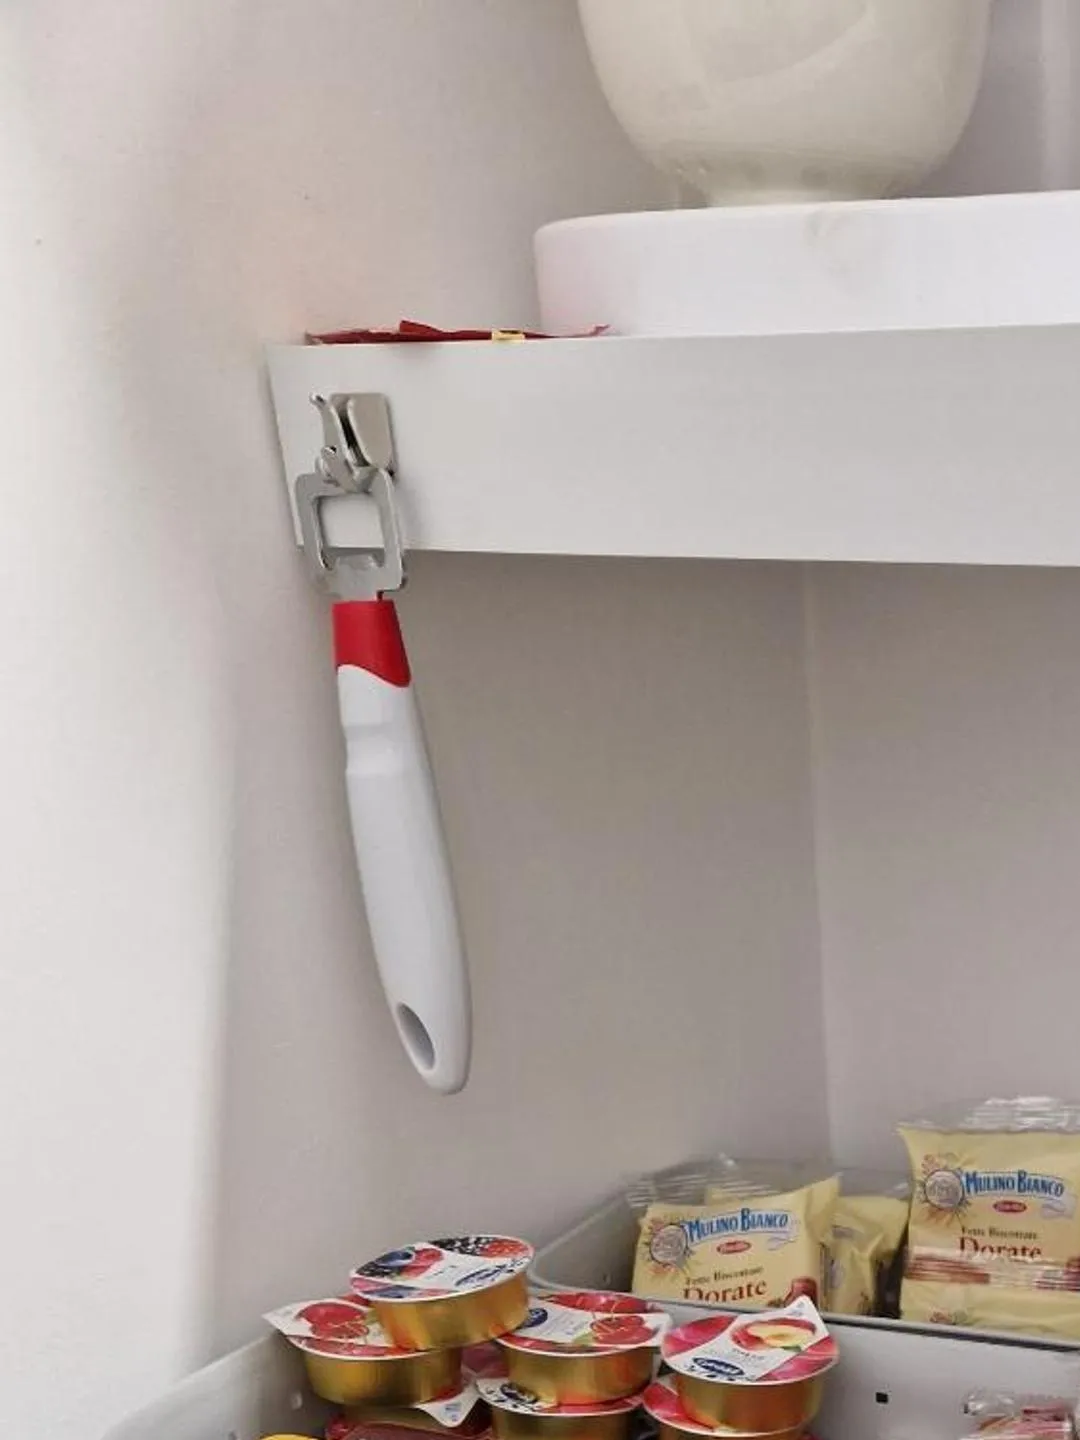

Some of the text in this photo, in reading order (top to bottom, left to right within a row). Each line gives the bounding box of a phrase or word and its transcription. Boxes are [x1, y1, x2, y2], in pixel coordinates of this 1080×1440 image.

[964, 1169, 1065, 1197] MULINO BIANCO
[688, 1207, 788, 1242] MULINO BIANCO
